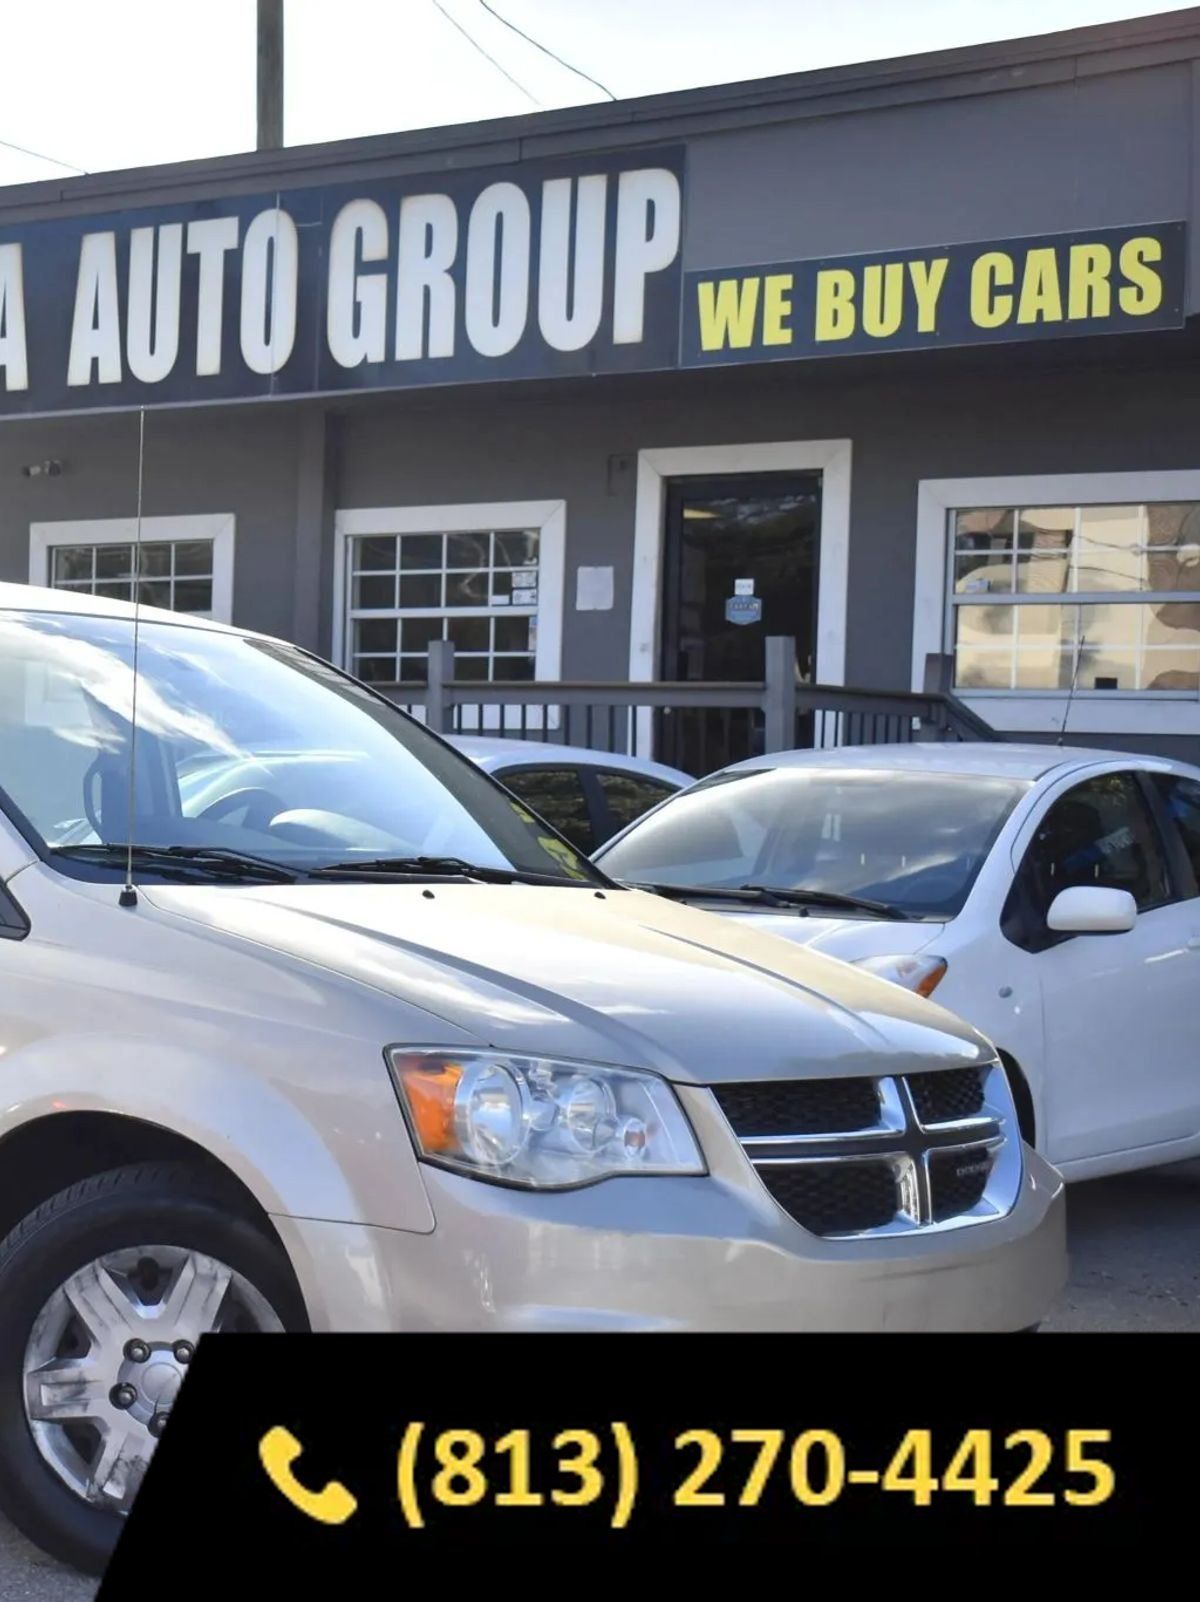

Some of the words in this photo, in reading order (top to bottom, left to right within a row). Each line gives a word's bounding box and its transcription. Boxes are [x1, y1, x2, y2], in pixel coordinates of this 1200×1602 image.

[66, 208, 298, 387] AUTO
[326, 168, 681, 369] GROUP
[697, 275, 793, 351] WE
[815, 258, 949, 342] BUY
[970, 236, 1163, 328] CARS
